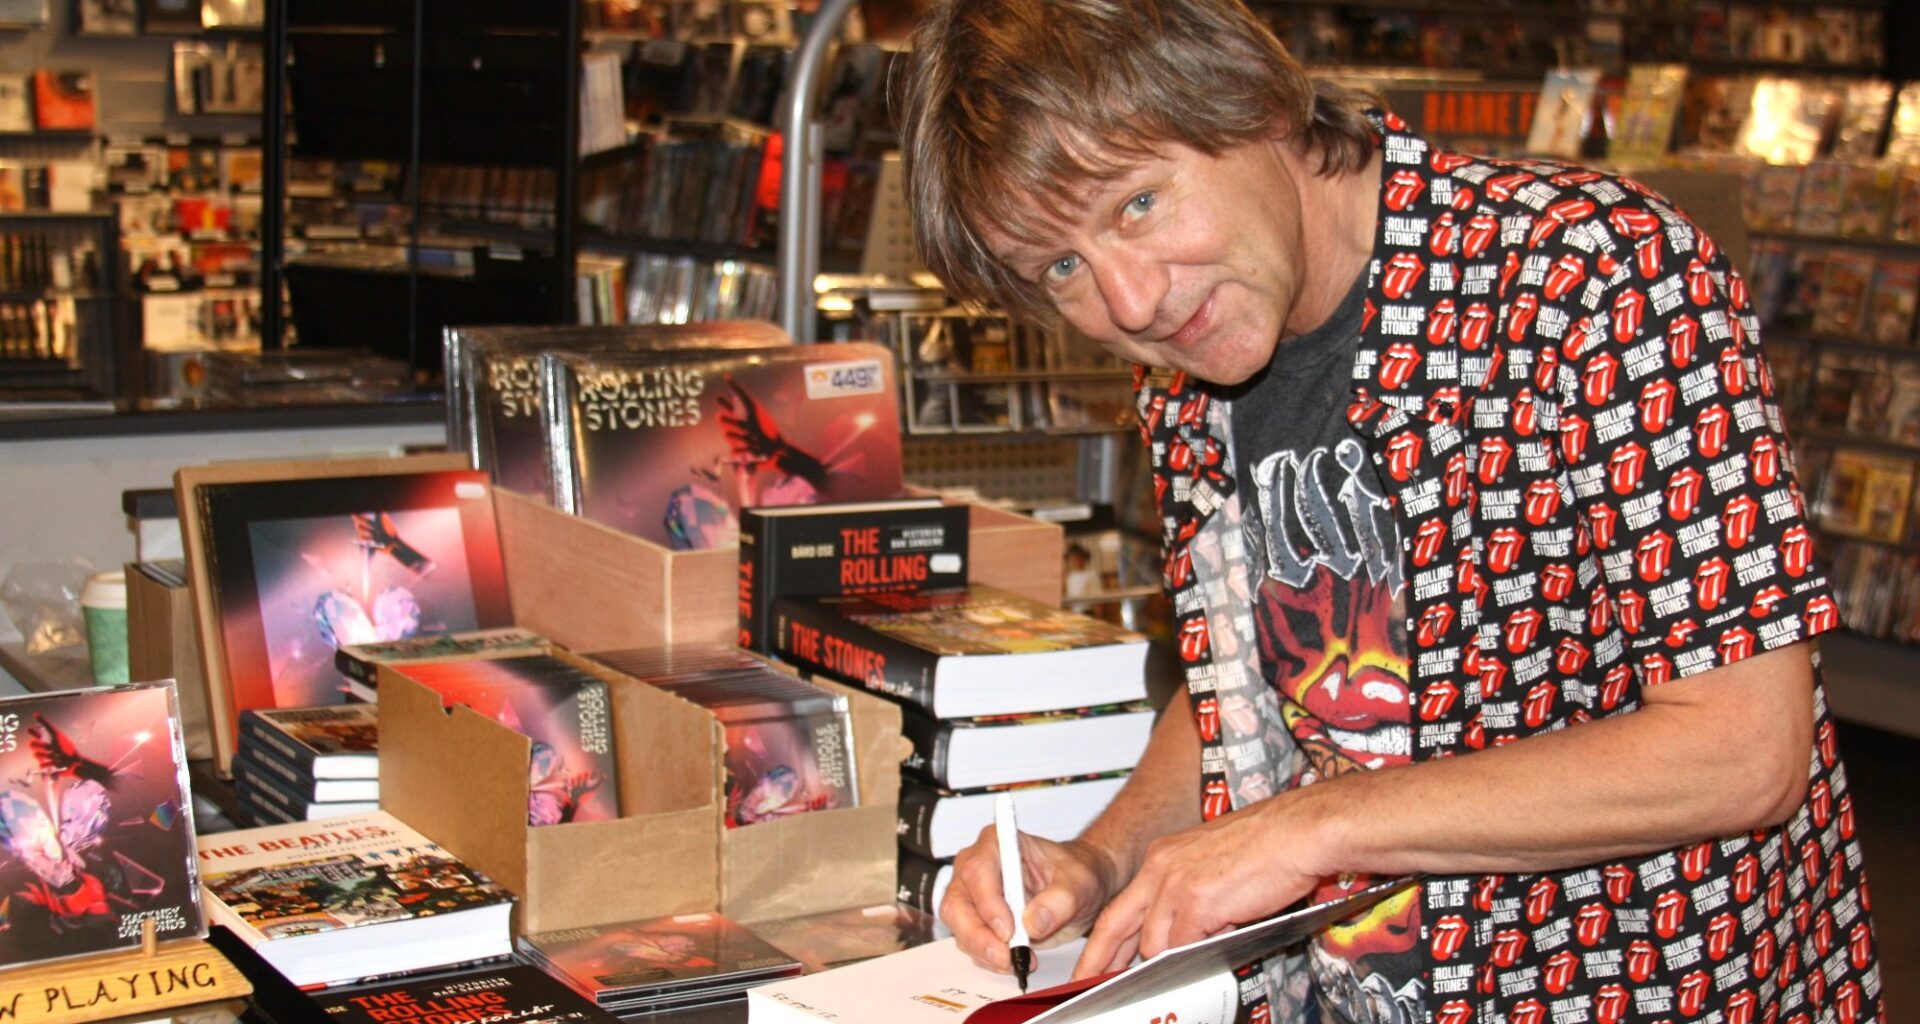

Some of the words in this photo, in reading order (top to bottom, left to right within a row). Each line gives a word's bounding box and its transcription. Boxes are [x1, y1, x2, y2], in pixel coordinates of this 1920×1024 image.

[1388, 136, 1428, 152] ROLLING
[1385, 149, 1421, 165] STONES
[1388, 216, 1429, 234] ROLLING
[1384, 231, 1422, 247] STONES
[1649, 273, 1684, 302] ROLLING
[1384, 305, 1426, 321] ROLLING
[1652, 290, 1684, 317] STONES
[1381, 319, 1419, 336] STONES
[1624, 336, 1665, 364] ROLLING
[1626, 353, 1664, 382] STONES
[1679, 363, 1719, 390] ROLLING
[577, 369, 703, 402] ROLLING
[1682, 379, 1719, 407] STONES
[586, 400, 701, 430] STONES
[1474, 398, 1509, 414] ROLLING
[1594, 401, 1636, 428] ROLLING
[1374, 411, 1409, 438] STONES
[1474, 413, 1505, 429] STONES
[1596, 418, 1635, 445] STONES
[1653, 426, 1692, 454] ROLLING
[1655, 442, 1691, 471] STONES
[1709, 452, 1748, 480] ROLLING
[1711, 469, 1746, 496] STONES
[1404, 493, 1440, 518] STONES
[1482, 488, 1521, 505] ROLLING
[1622, 489, 1663, 516] ROLLING
[1481, 503, 1517, 521] STONES
[1625, 507, 1661, 531] STONES
[840, 527, 880, 556] THE
[1533, 527, 1574, 545] ROLLING
[1678, 516, 1720, 544] ROLLING
[1533, 543, 1569, 557] STONES
[1681, 532, 1720, 558] STONES
[1735, 543, 1777, 571] ROLLING
[841, 554, 927, 586] ROLLING
[1416, 564, 1454, 589] ROLLING
[1736, 561, 1776, 587] STONES
[1415, 580, 1450, 602] STONES
[1494, 571, 1537, 594] ROLLING
[1650, 578, 1692, 604] ROLLING
[1496, 587, 1534, 607] STONES
[1653, 595, 1690, 619] STONES
[1759, 614, 1801, 642] ROLLING
[791, 622, 821, 664] THE
[823, 635, 886, 686] STONES
[1420, 647, 1460, 667] ROLLING
[1515, 646, 1552, 673] ROLLING
[1677, 645, 1716, 669] ROLLING
[1418, 662, 1454, 678] STONES
[1514, 662, 1550, 686] STONES
[1480, 702, 1519, 717] ROLLING
[1481, 714, 1516, 729] STONES
[1421, 722, 1462, 738] ROLLING
[198, 844, 256, 861] THE
[258, 825, 388, 850] BEATLES
[1638, 852, 1677, 882] ROLLING
[1566, 869, 1601, 890] ROLLING
[1641, 867, 1676, 892] STONES
[1692, 875, 1731, 903] ROLLING
[1565, 883, 1601, 902] STONES
[1694, 891, 1730, 916] STONES
[1534, 917, 1572, 941] ROLLING
[1617, 920, 1649, 933] STONES
[1535, 930, 1570, 952] STONES
[1663, 933, 1704, 959] ROLLING
[1586, 949, 1624, 967] ROLLING
[1666, 950, 1702, 971] STONES
[1435, 964, 1475, 980] ROLLING
[1500, 966, 1540, 985] ROLLING
[1586, 963, 1621, 979] STONES
[1716, 967, 1749, 992] STONES
[44, 963, 215, 1013] PLAYING
[1433, 978, 1470, 994] STONES
[1501, 981, 1537, 998] STONES
[1635, 985, 1674, 1004] ROLLING
[349, 992, 415, 1010] THE
[367, 991, 507, 1022] ROLLING
[1552, 994, 1591, 1015] ROLLING
[1637, 998, 1672, 1015] STONES
